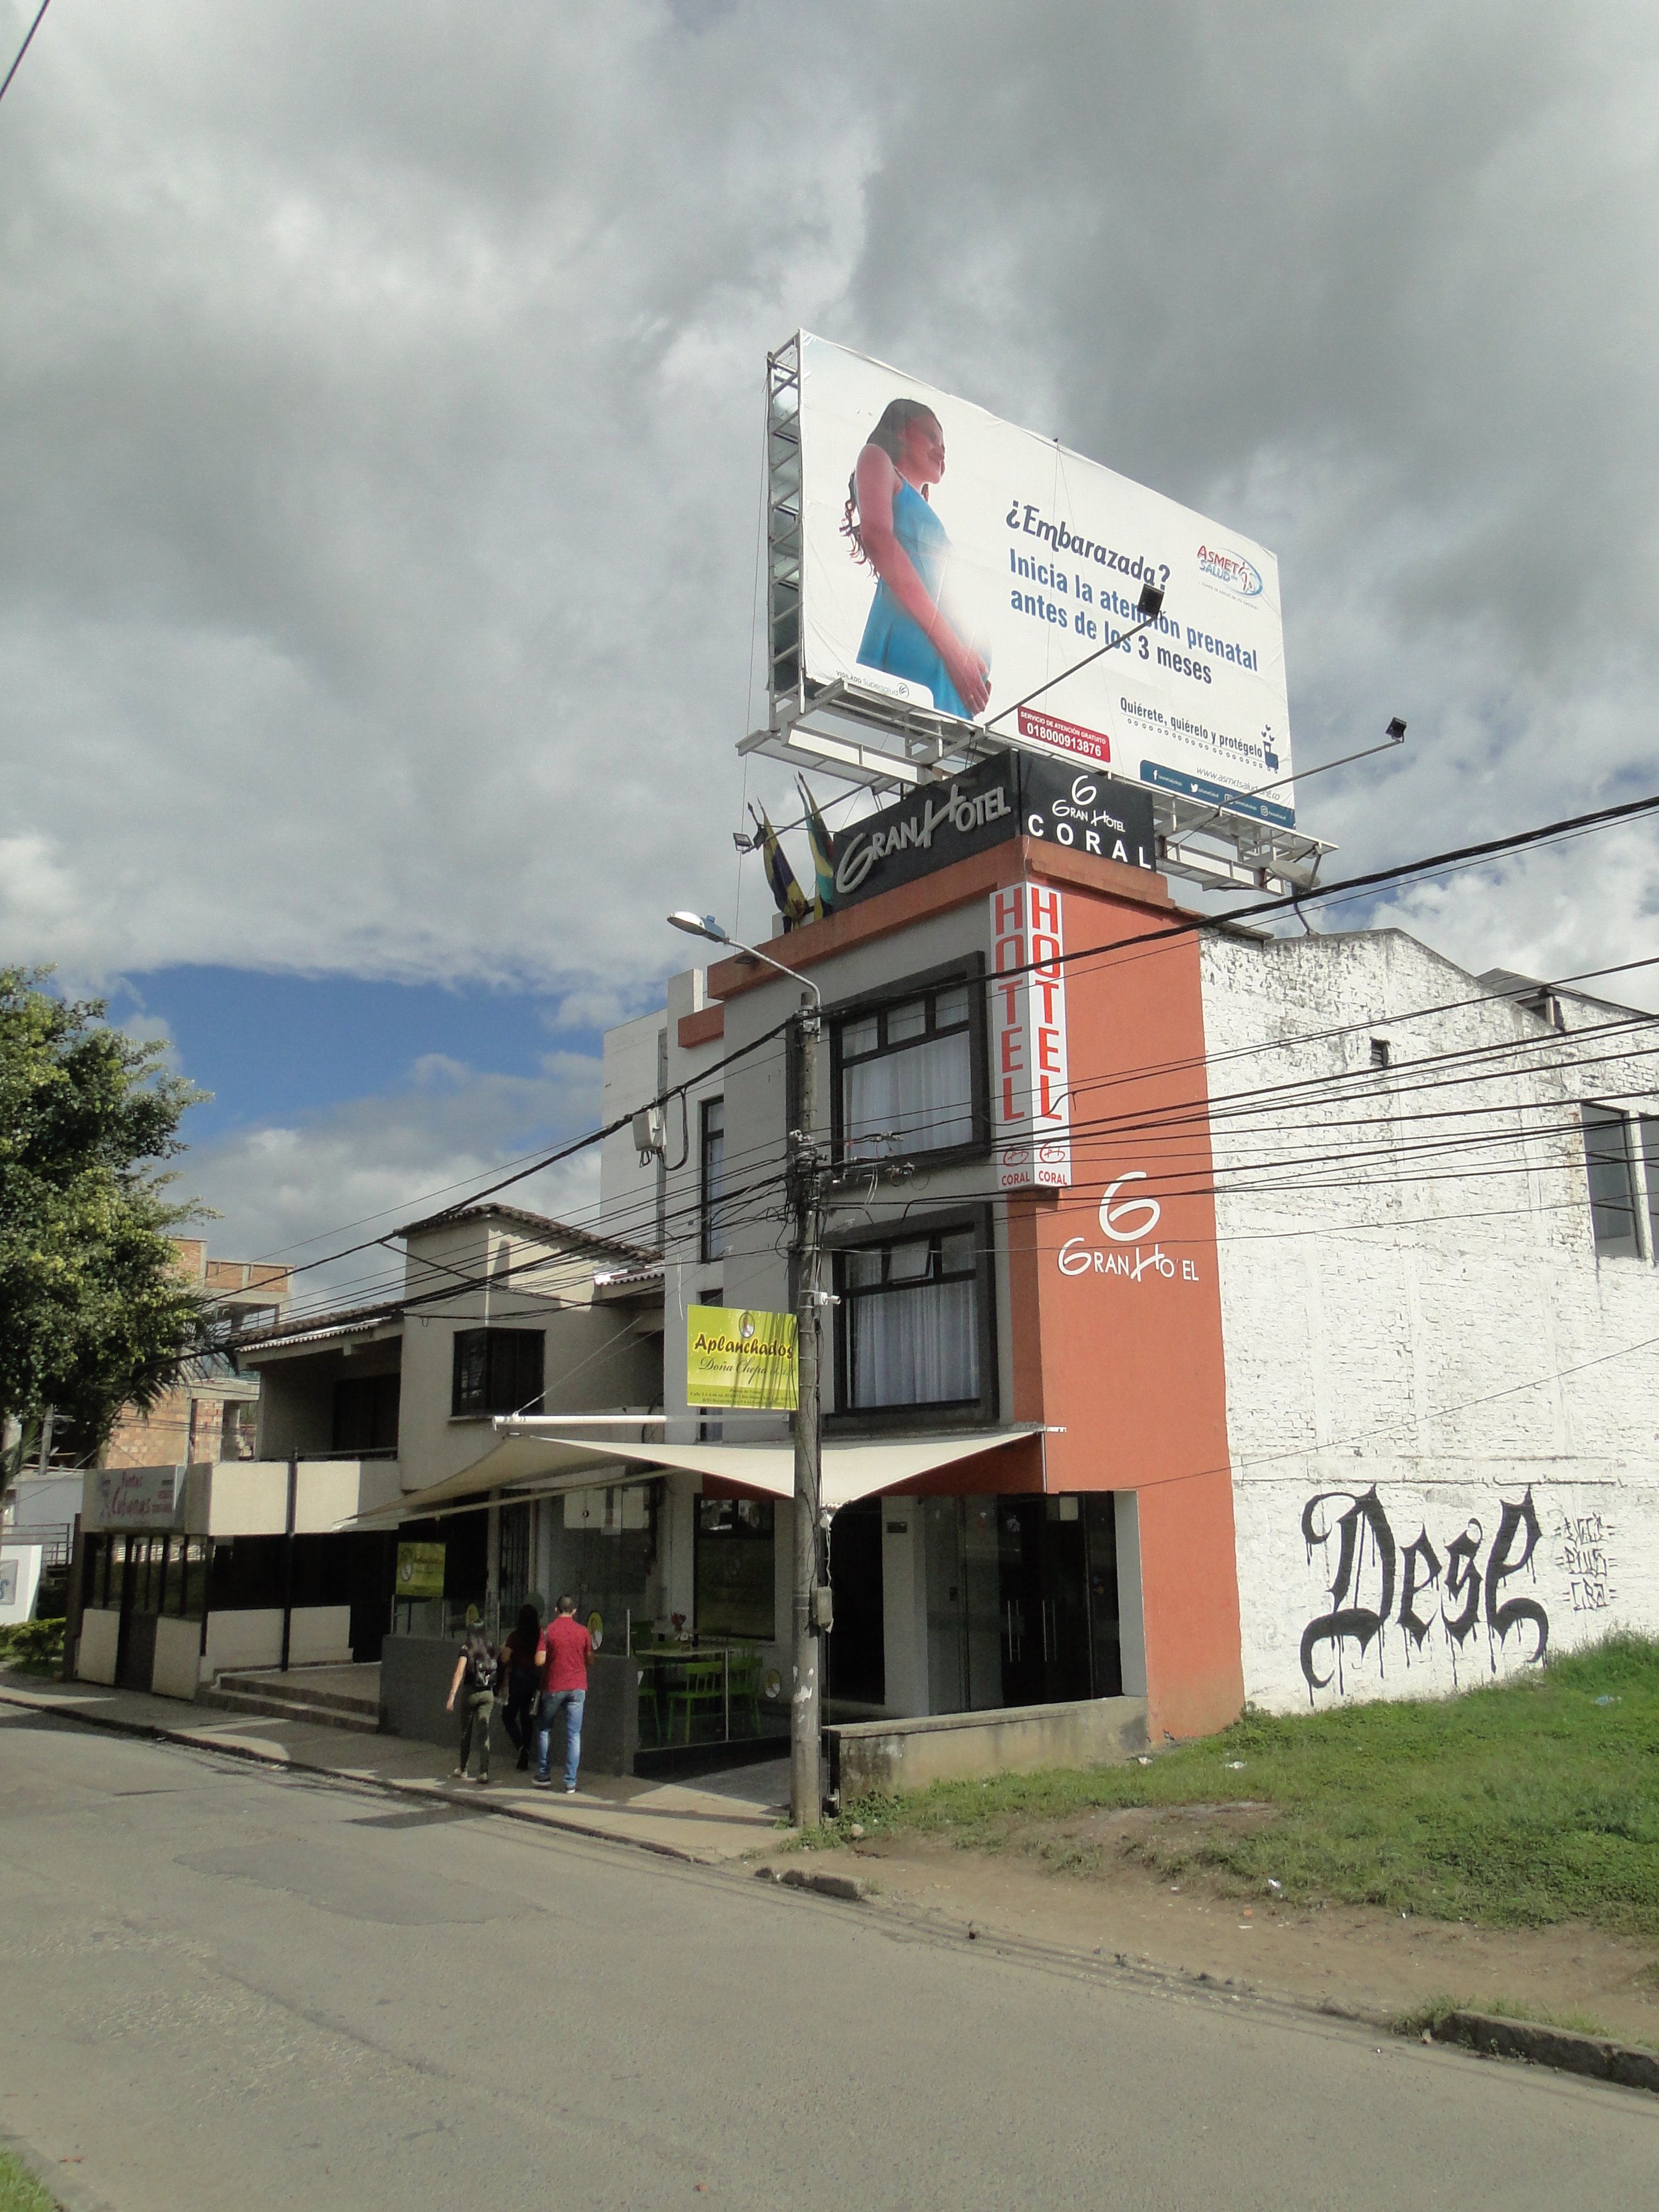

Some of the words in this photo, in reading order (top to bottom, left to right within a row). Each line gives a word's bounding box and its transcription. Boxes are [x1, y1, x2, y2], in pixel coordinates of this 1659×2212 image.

[1006, 500, 1171, 591] ¿Embarazada?
[1197, 545, 1239, 573] ASMET
[1199, 559, 1230, 582] SALUD
[1010, 548, 1068, 594] Inicia
[1075, 574, 1093, 604] la
[1187, 627, 1258, 672] prenatal
[1010, 590, 1068, 629] antes
[1075, 611, 1097, 640] de
[1105, 620, 1132, 653] los
[1138, 635, 1150, 660] 3
[1157, 646, 1212, 684] meses
[836, 670, 862, 684] VIGILADO
[1020, 710, 1046, 725] SERVICIO
[1054, 722, 1080, 736] ATENCIÓN
[1080, 732, 1107, 745] GRATUITO
[1027, 722, 1102, 757] 018000913876
[1120, 697, 1167, 726] Quiérete,
[1171, 716, 1208, 739] quiérelo
[1211, 731, 1216, 744] y
[1219, 734, 1263, 758] protégelo
[1052, 799, 1088, 822] GRAN
[1090, 809, 1126, 833] HOTEL
[836, 817, 918, 894] GRAN
[915, 783, 1012, 849] HOTEL
[1028, 814, 1151, 869] CORAL
[995, 886, 1025, 1121] HOTEL
[1030, 886, 1062, 1121] HOTEL
[1002, 1171, 1030, 1186] CORAL
[1038, 1170, 1068, 1185] CORAL
[1057, 1237, 1130, 1276] GRAN
[1130, 1243, 1199, 1283] HOEL
[694, 1333, 794, 1359] Aplanchados
